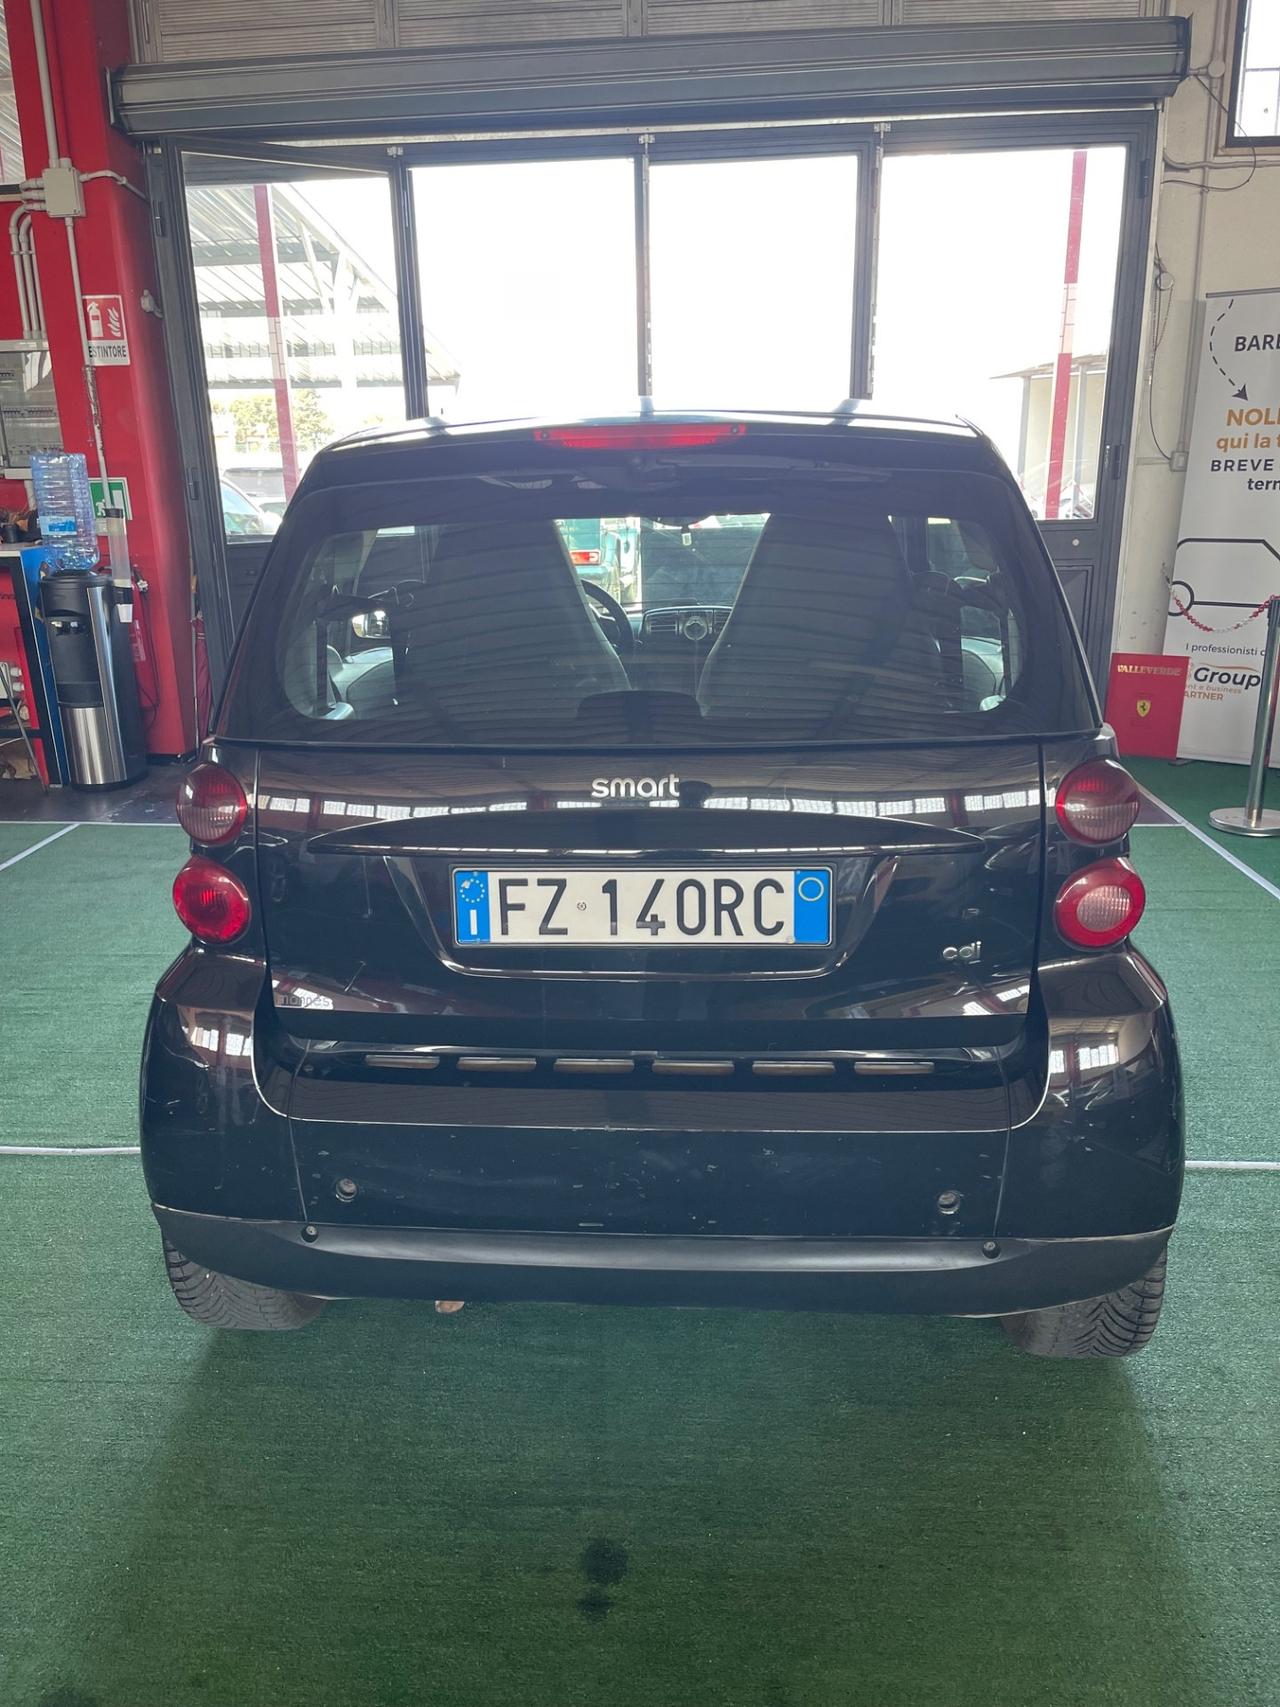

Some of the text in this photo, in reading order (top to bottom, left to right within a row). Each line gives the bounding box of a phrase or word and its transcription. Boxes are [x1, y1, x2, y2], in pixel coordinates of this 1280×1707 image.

[89, 345, 126, 358] ESTINTORE
[1216, 433, 1248, 453] qui
[1254, 433, 1271, 448] la
[1211, 459, 1274, 472] BREVE
[1191, 644, 1258, 656] professionisti
[1193, 667, 1261, 690] Group
[1184, 691, 1224, 700] ARTNER
[1206, 685, 1242, 694] business
[591, 773, 680, 798] smart
[499, 878, 785, 936] FZ 140RC
[942, 941, 982, 959] cdi
